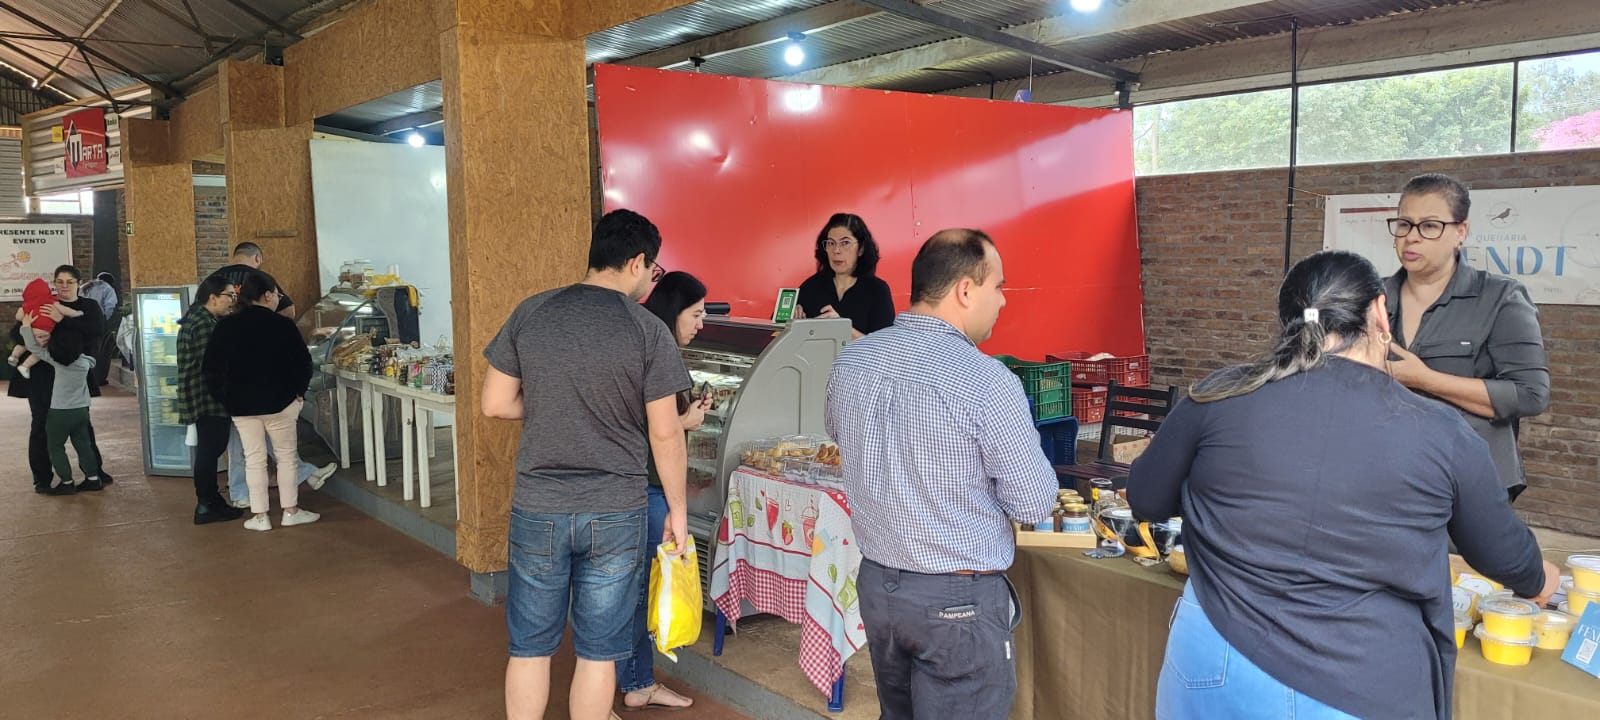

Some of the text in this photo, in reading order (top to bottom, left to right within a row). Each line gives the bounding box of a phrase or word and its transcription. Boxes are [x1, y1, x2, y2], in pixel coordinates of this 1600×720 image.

[70, 134, 103, 161] MARTA
[1461, 246, 1577, 276] ENDT
[938, 610, 975, 619] PAMPEANA
